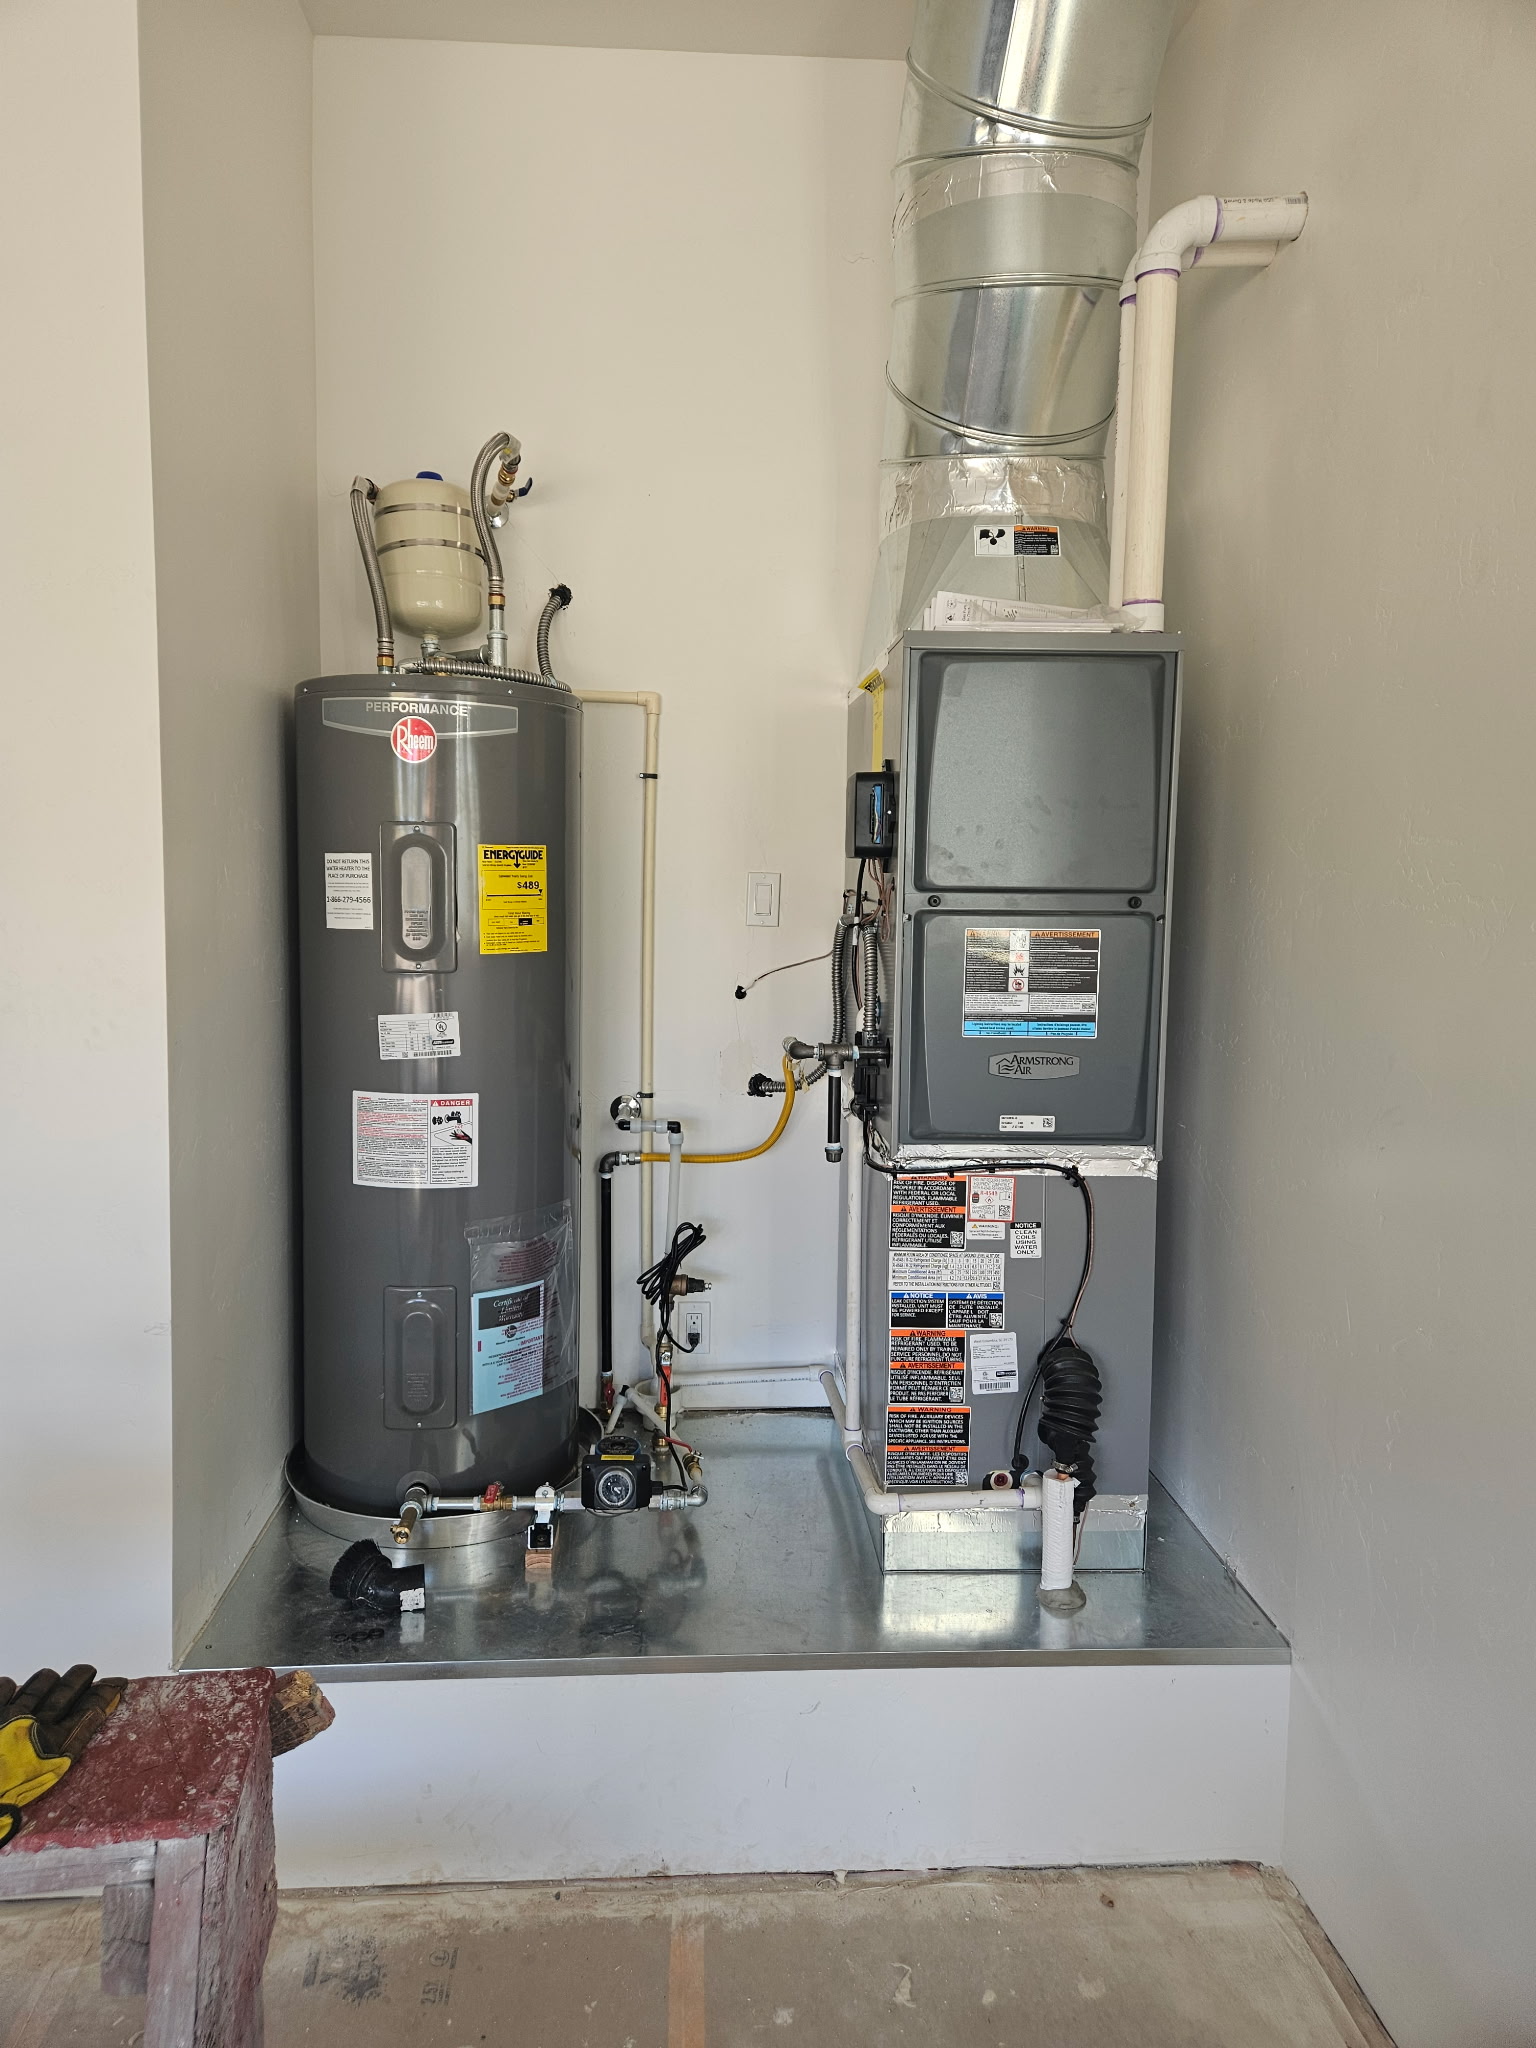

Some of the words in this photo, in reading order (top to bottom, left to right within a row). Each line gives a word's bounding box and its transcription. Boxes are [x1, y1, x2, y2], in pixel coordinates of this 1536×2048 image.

[366, 702, 468, 716] PERFORMANCE
[396, 718, 434, 755] Rheem
[484, 850, 544, 860] ENERGYGUIDE
[517, 881, 540, 889] $489
[1011, 1055, 1073, 1065] ARMSTRONG
[1014, 1065, 1032, 1074] AIR
[521, 1335, 543, 1346] IMPORTANT
